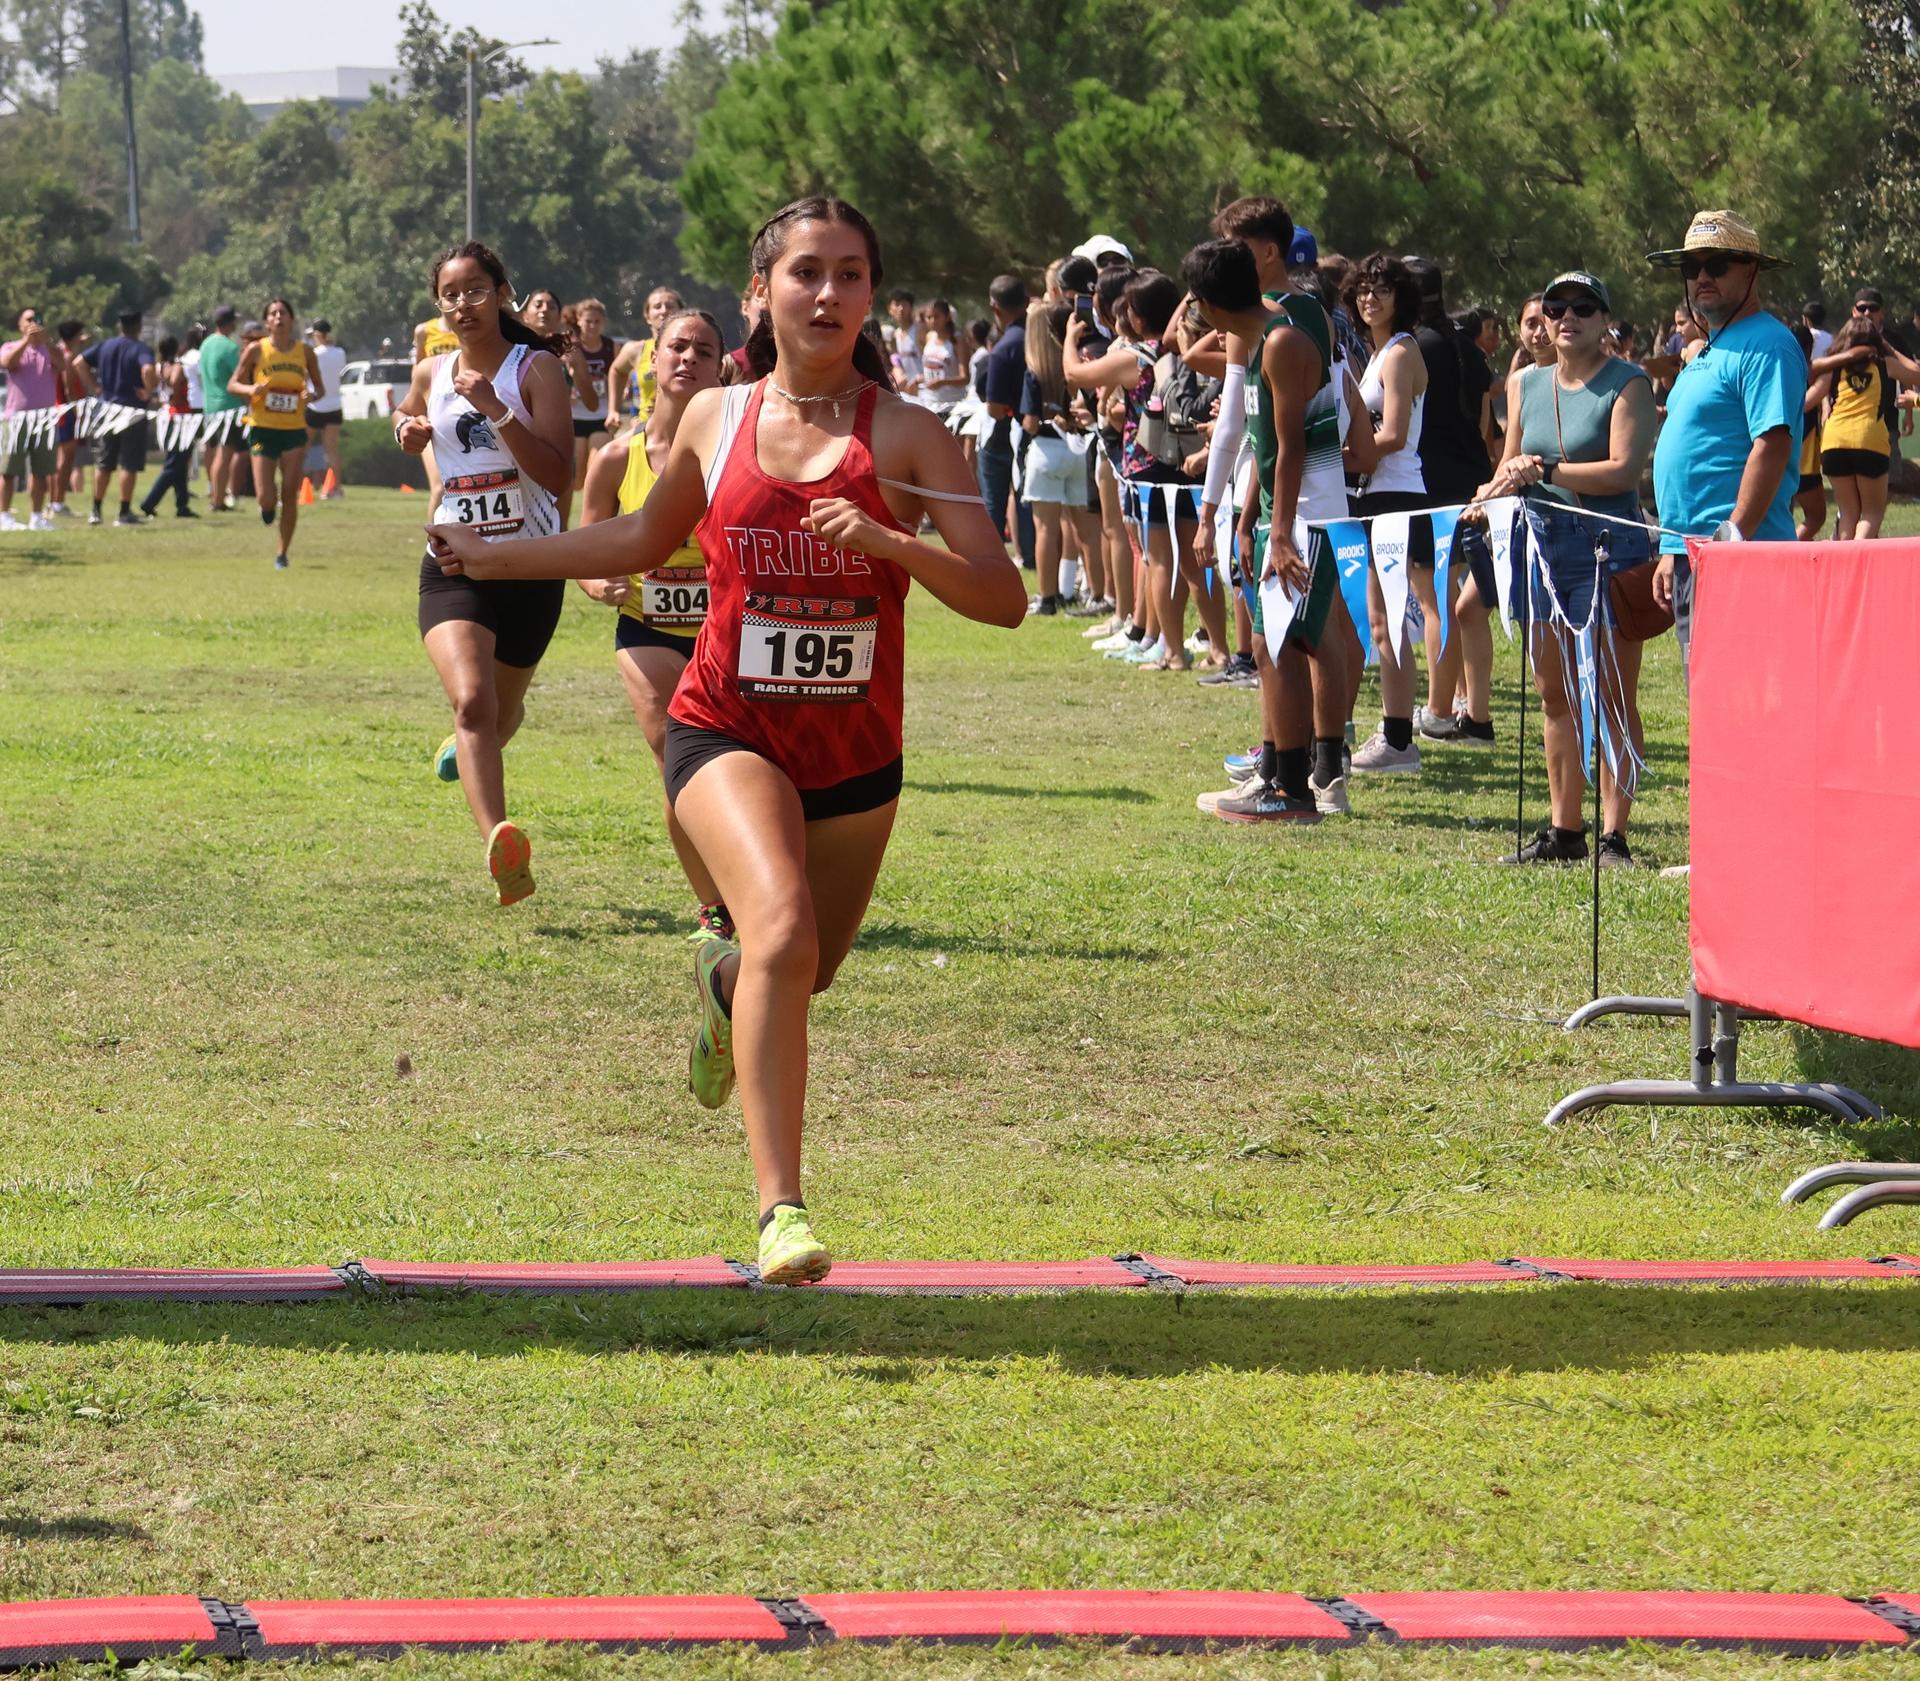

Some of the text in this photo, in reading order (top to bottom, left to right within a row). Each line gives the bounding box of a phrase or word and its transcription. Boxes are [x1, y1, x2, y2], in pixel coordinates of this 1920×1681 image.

[271, 394, 292, 409] 251
[458, 473, 504, 488] RTS
[457, 493, 511, 524] 314
[482, 521, 518, 532] TIMING
[1493, 527, 1509, 543] BROOKS
[724, 527, 871, 576] TRIBE
[1337, 544, 1365, 560] BROOKS
[1376, 542, 1405, 555] BROOKS
[657, 568, 705, 578] RTS
[655, 587, 709, 613] 304
[773, 596, 855, 616] RTS
[765, 631, 854, 679] 195
[754, 683, 858, 695] RACE TIMING
[1256, 800, 1287, 812] HOKA
